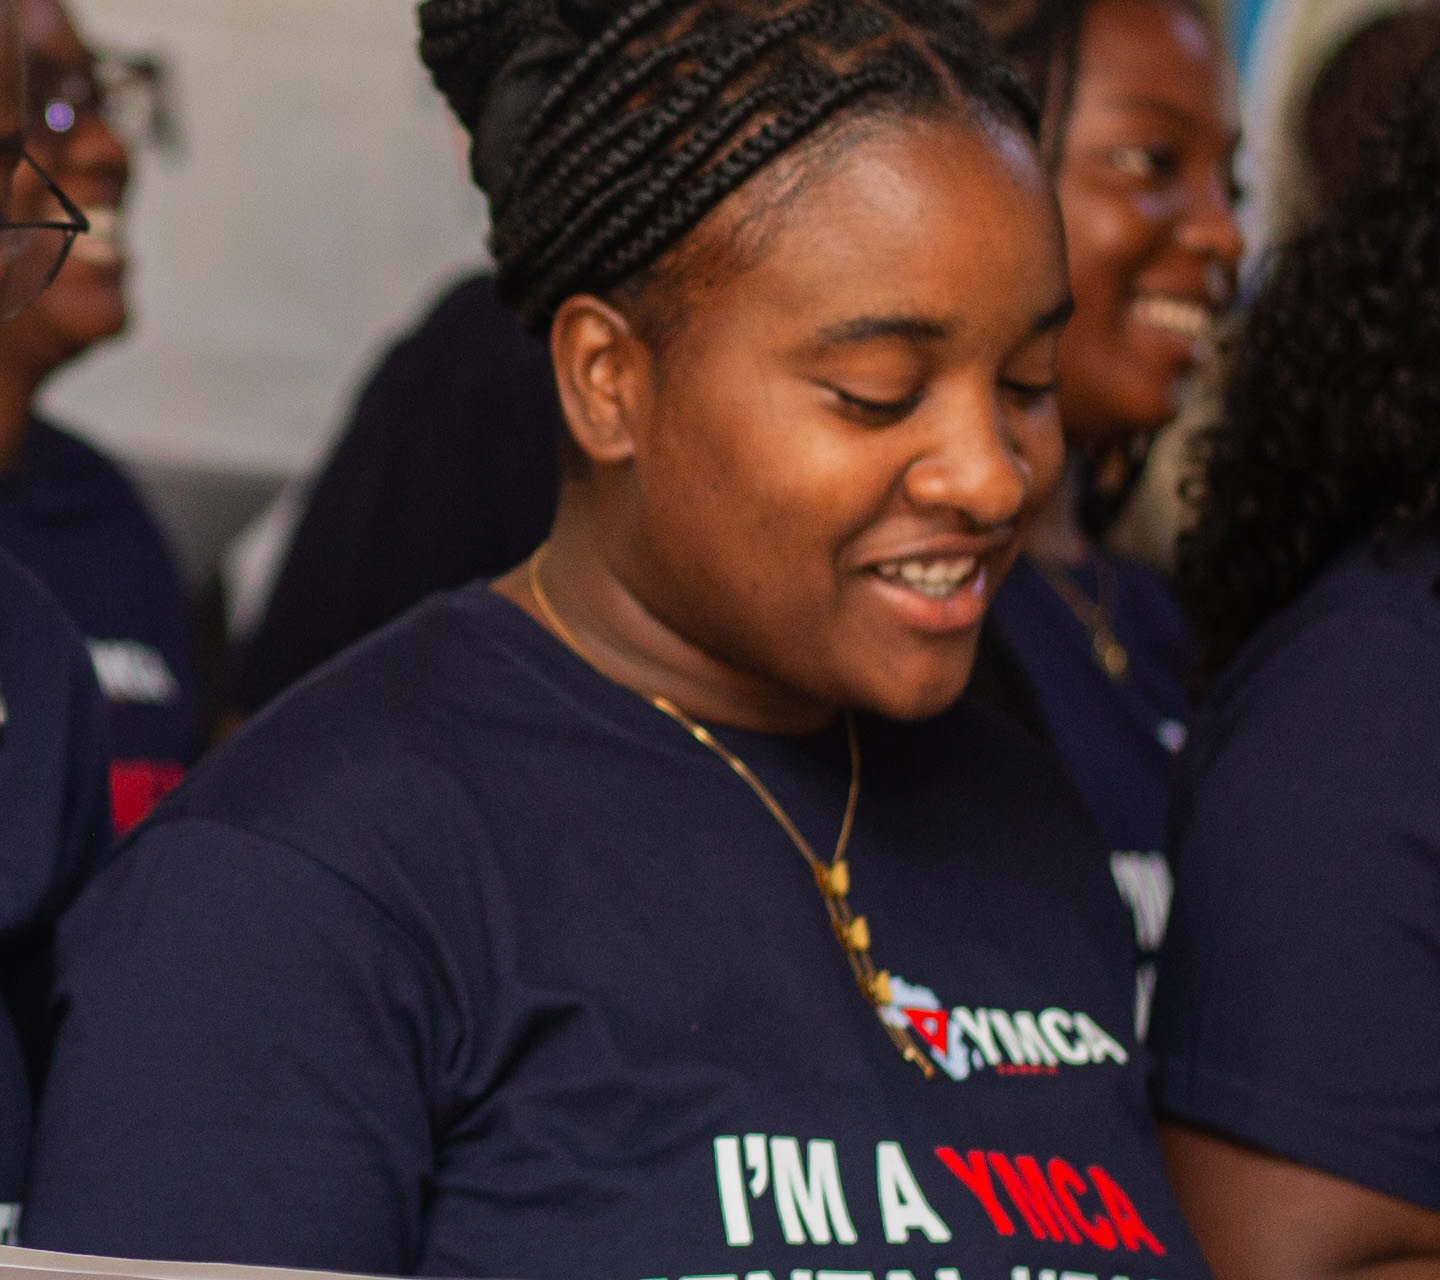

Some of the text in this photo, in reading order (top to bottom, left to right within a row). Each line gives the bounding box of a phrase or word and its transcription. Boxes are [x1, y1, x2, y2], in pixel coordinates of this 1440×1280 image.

[951, 1005, 1129, 1066] YMCA
[714, 1132, 1166, 1256] I'M A YMCA
